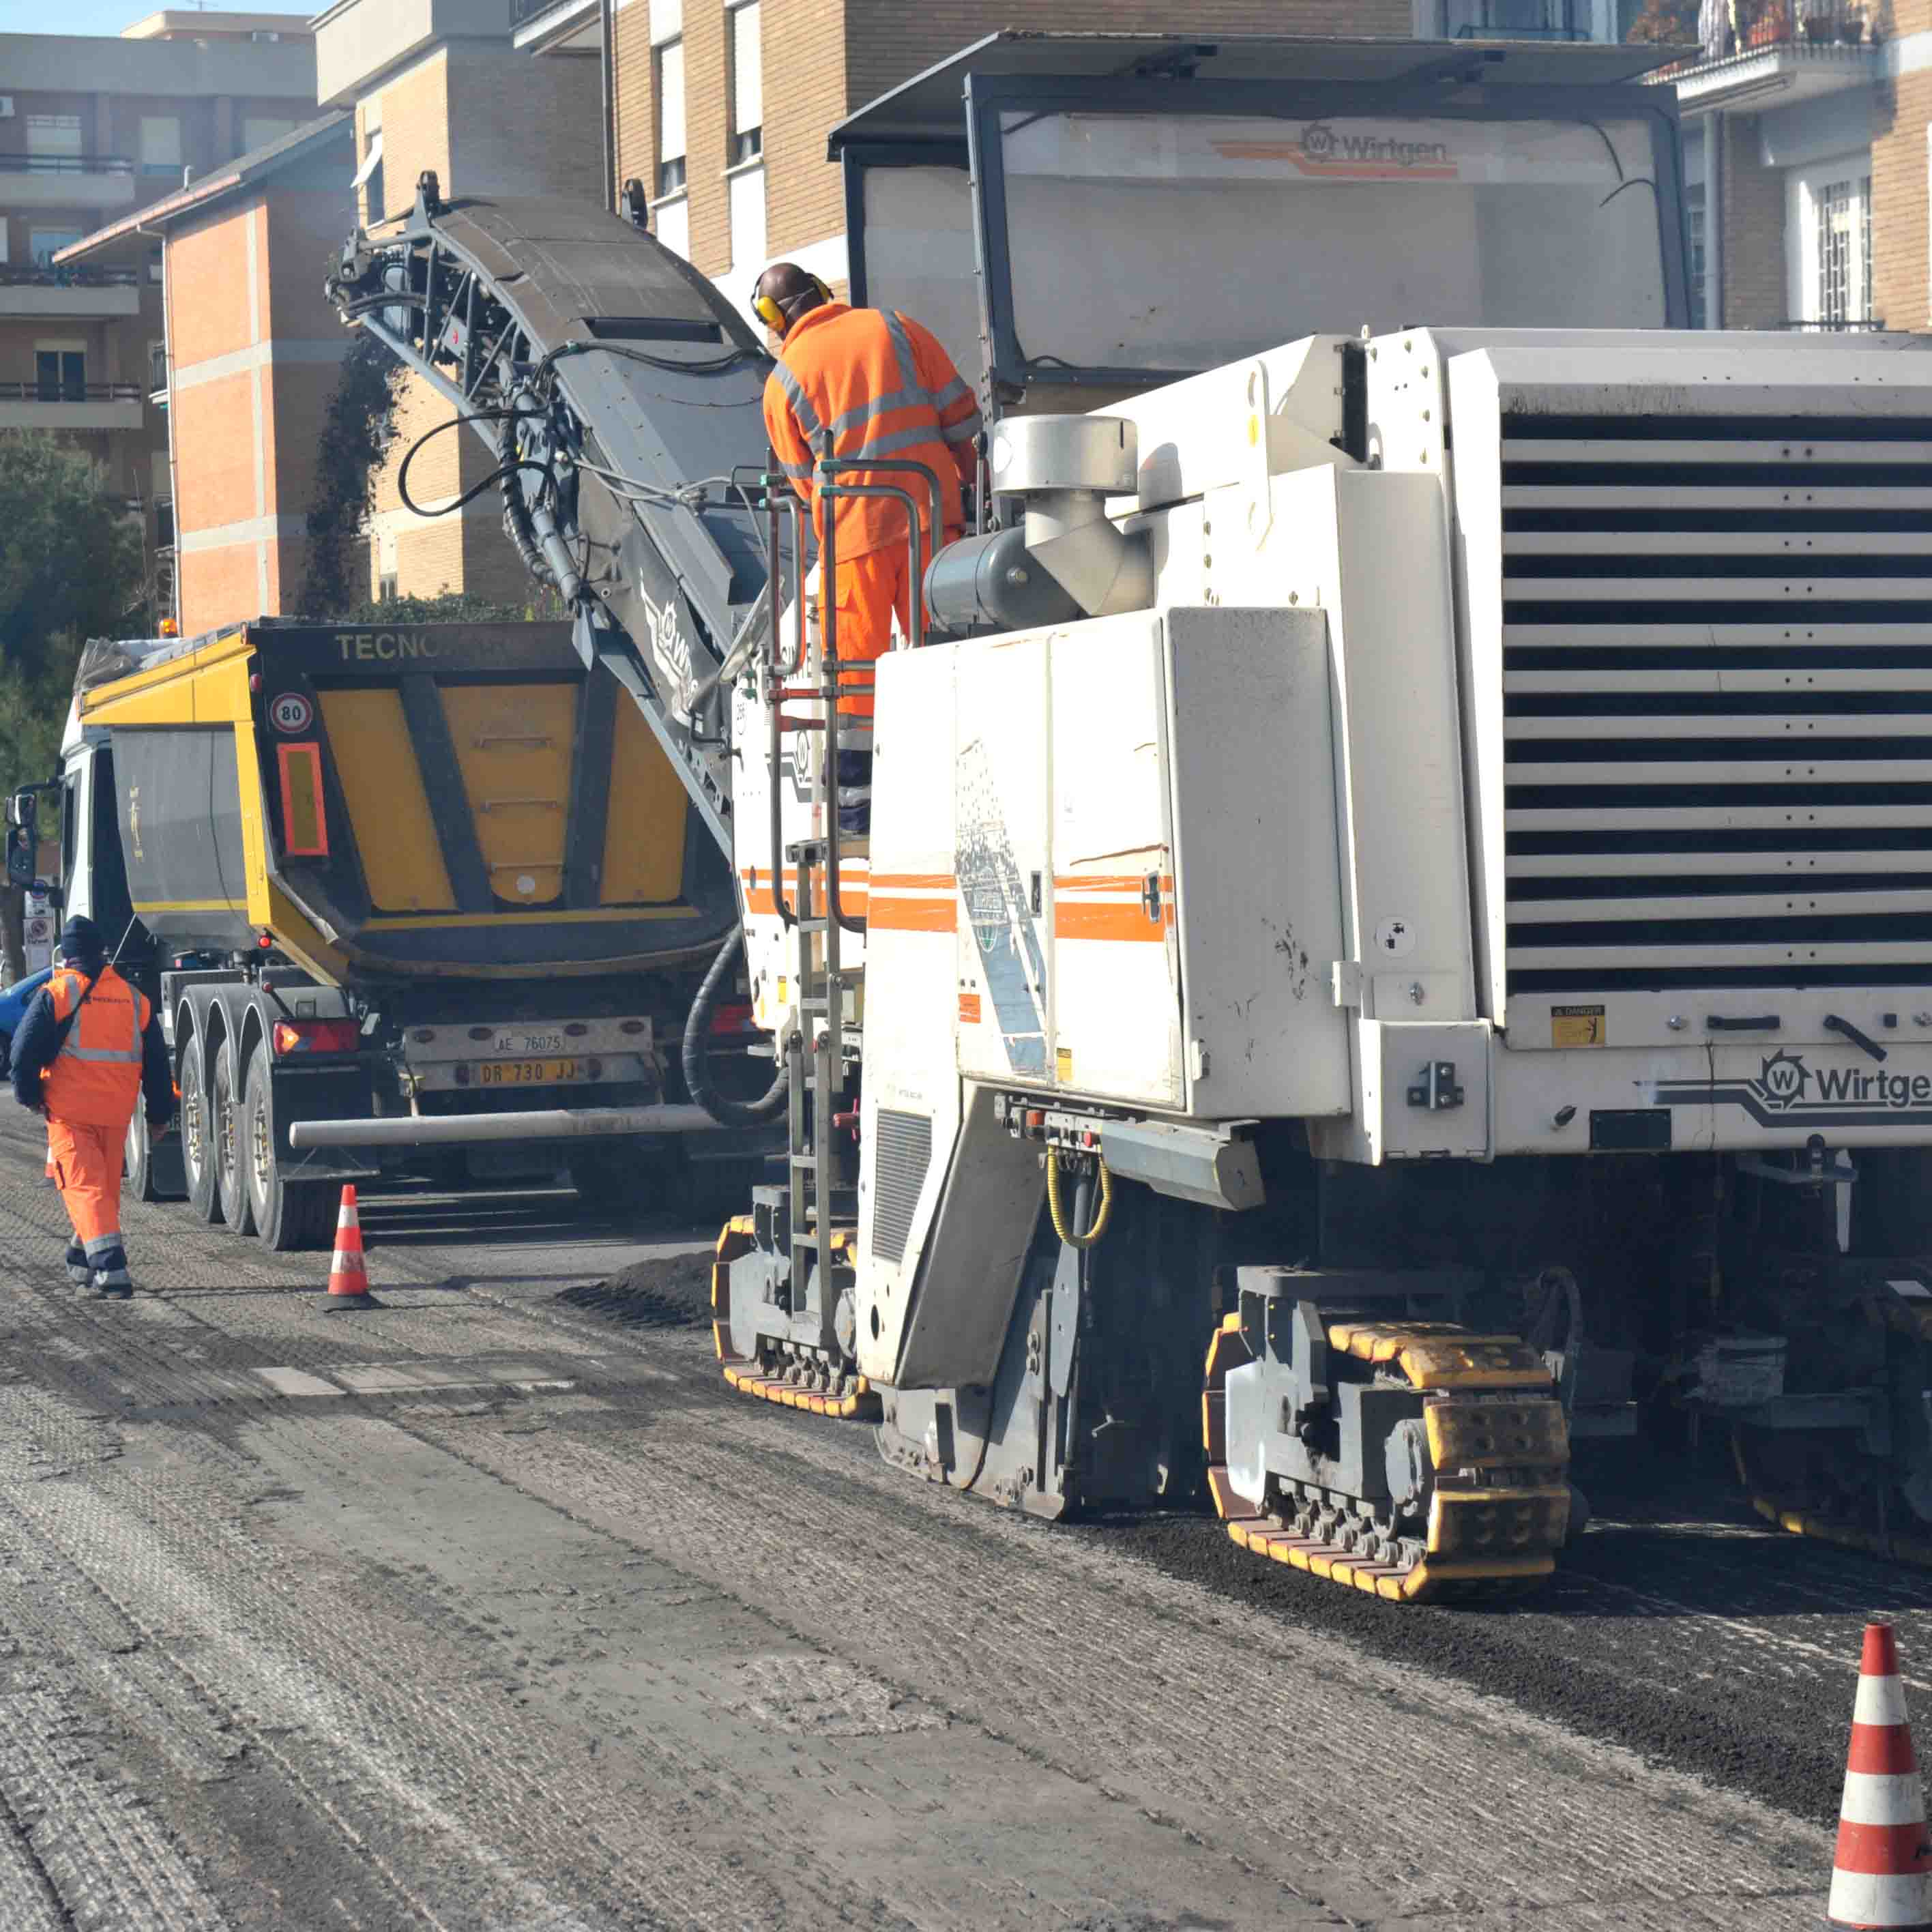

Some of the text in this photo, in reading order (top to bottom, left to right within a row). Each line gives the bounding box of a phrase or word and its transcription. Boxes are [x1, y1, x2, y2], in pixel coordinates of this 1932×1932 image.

[1341, 135, 1447, 169] Wirtgen
[282, 706, 301, 720] 80
[499, 1036, 561, 1051] AE 76075
[482, 1061, 574, 1083] DR 730 JJ
[1772, 1070, 1795, 1090] W
